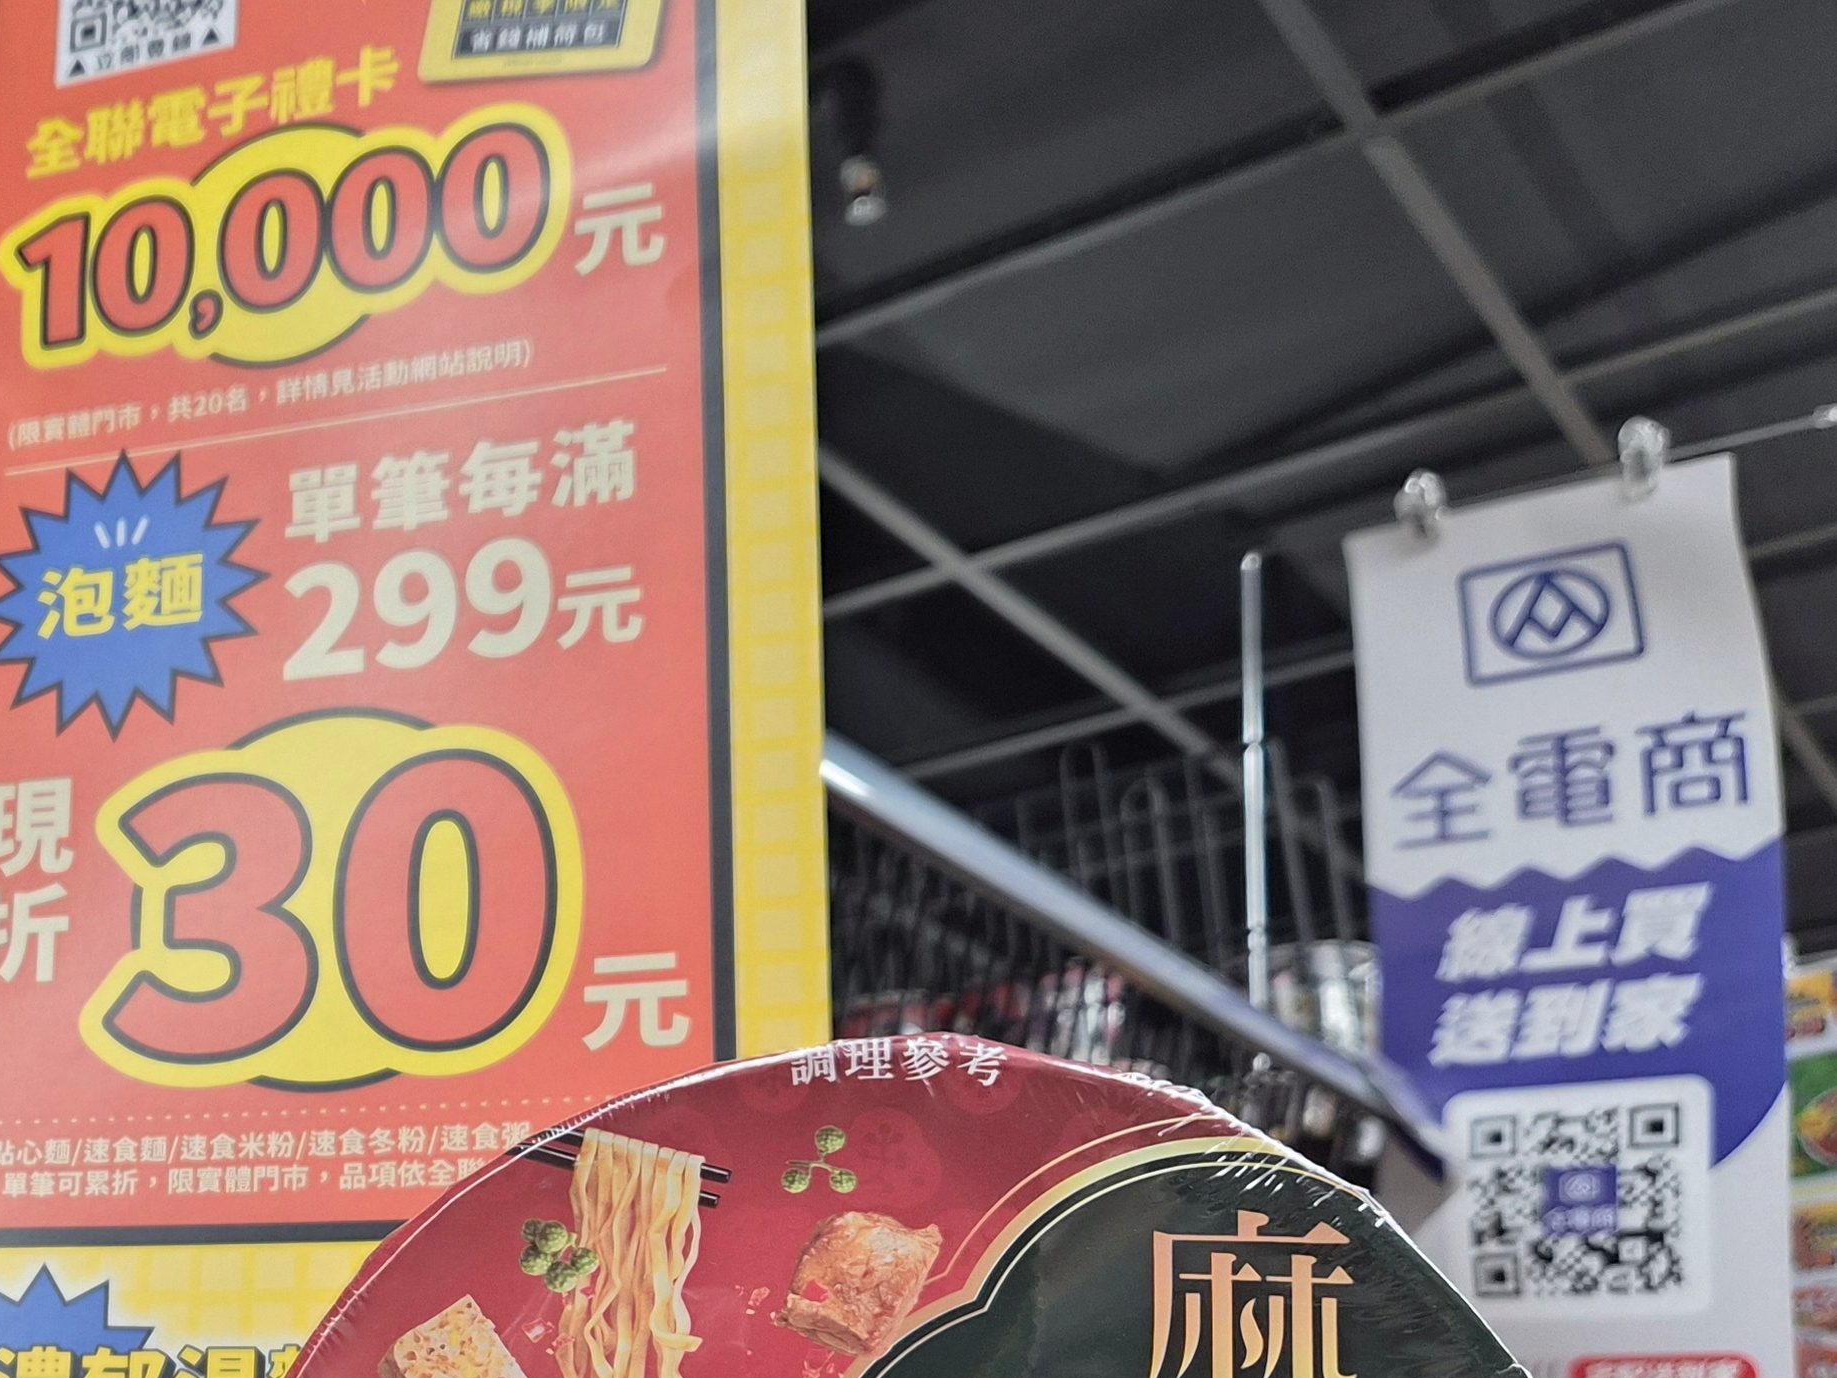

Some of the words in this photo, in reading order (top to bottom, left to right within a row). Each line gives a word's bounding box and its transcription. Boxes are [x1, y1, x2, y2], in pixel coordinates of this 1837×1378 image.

[25, 47, 401, 178] 全聯電子禮卡
[284, 420, 636, 545] 單筆每滿
[36, 552, 206, 640] 泡麵
[1392, 709, 1750, 851] 全電商
[789, 1038, 1010, 1087] 調理參考
